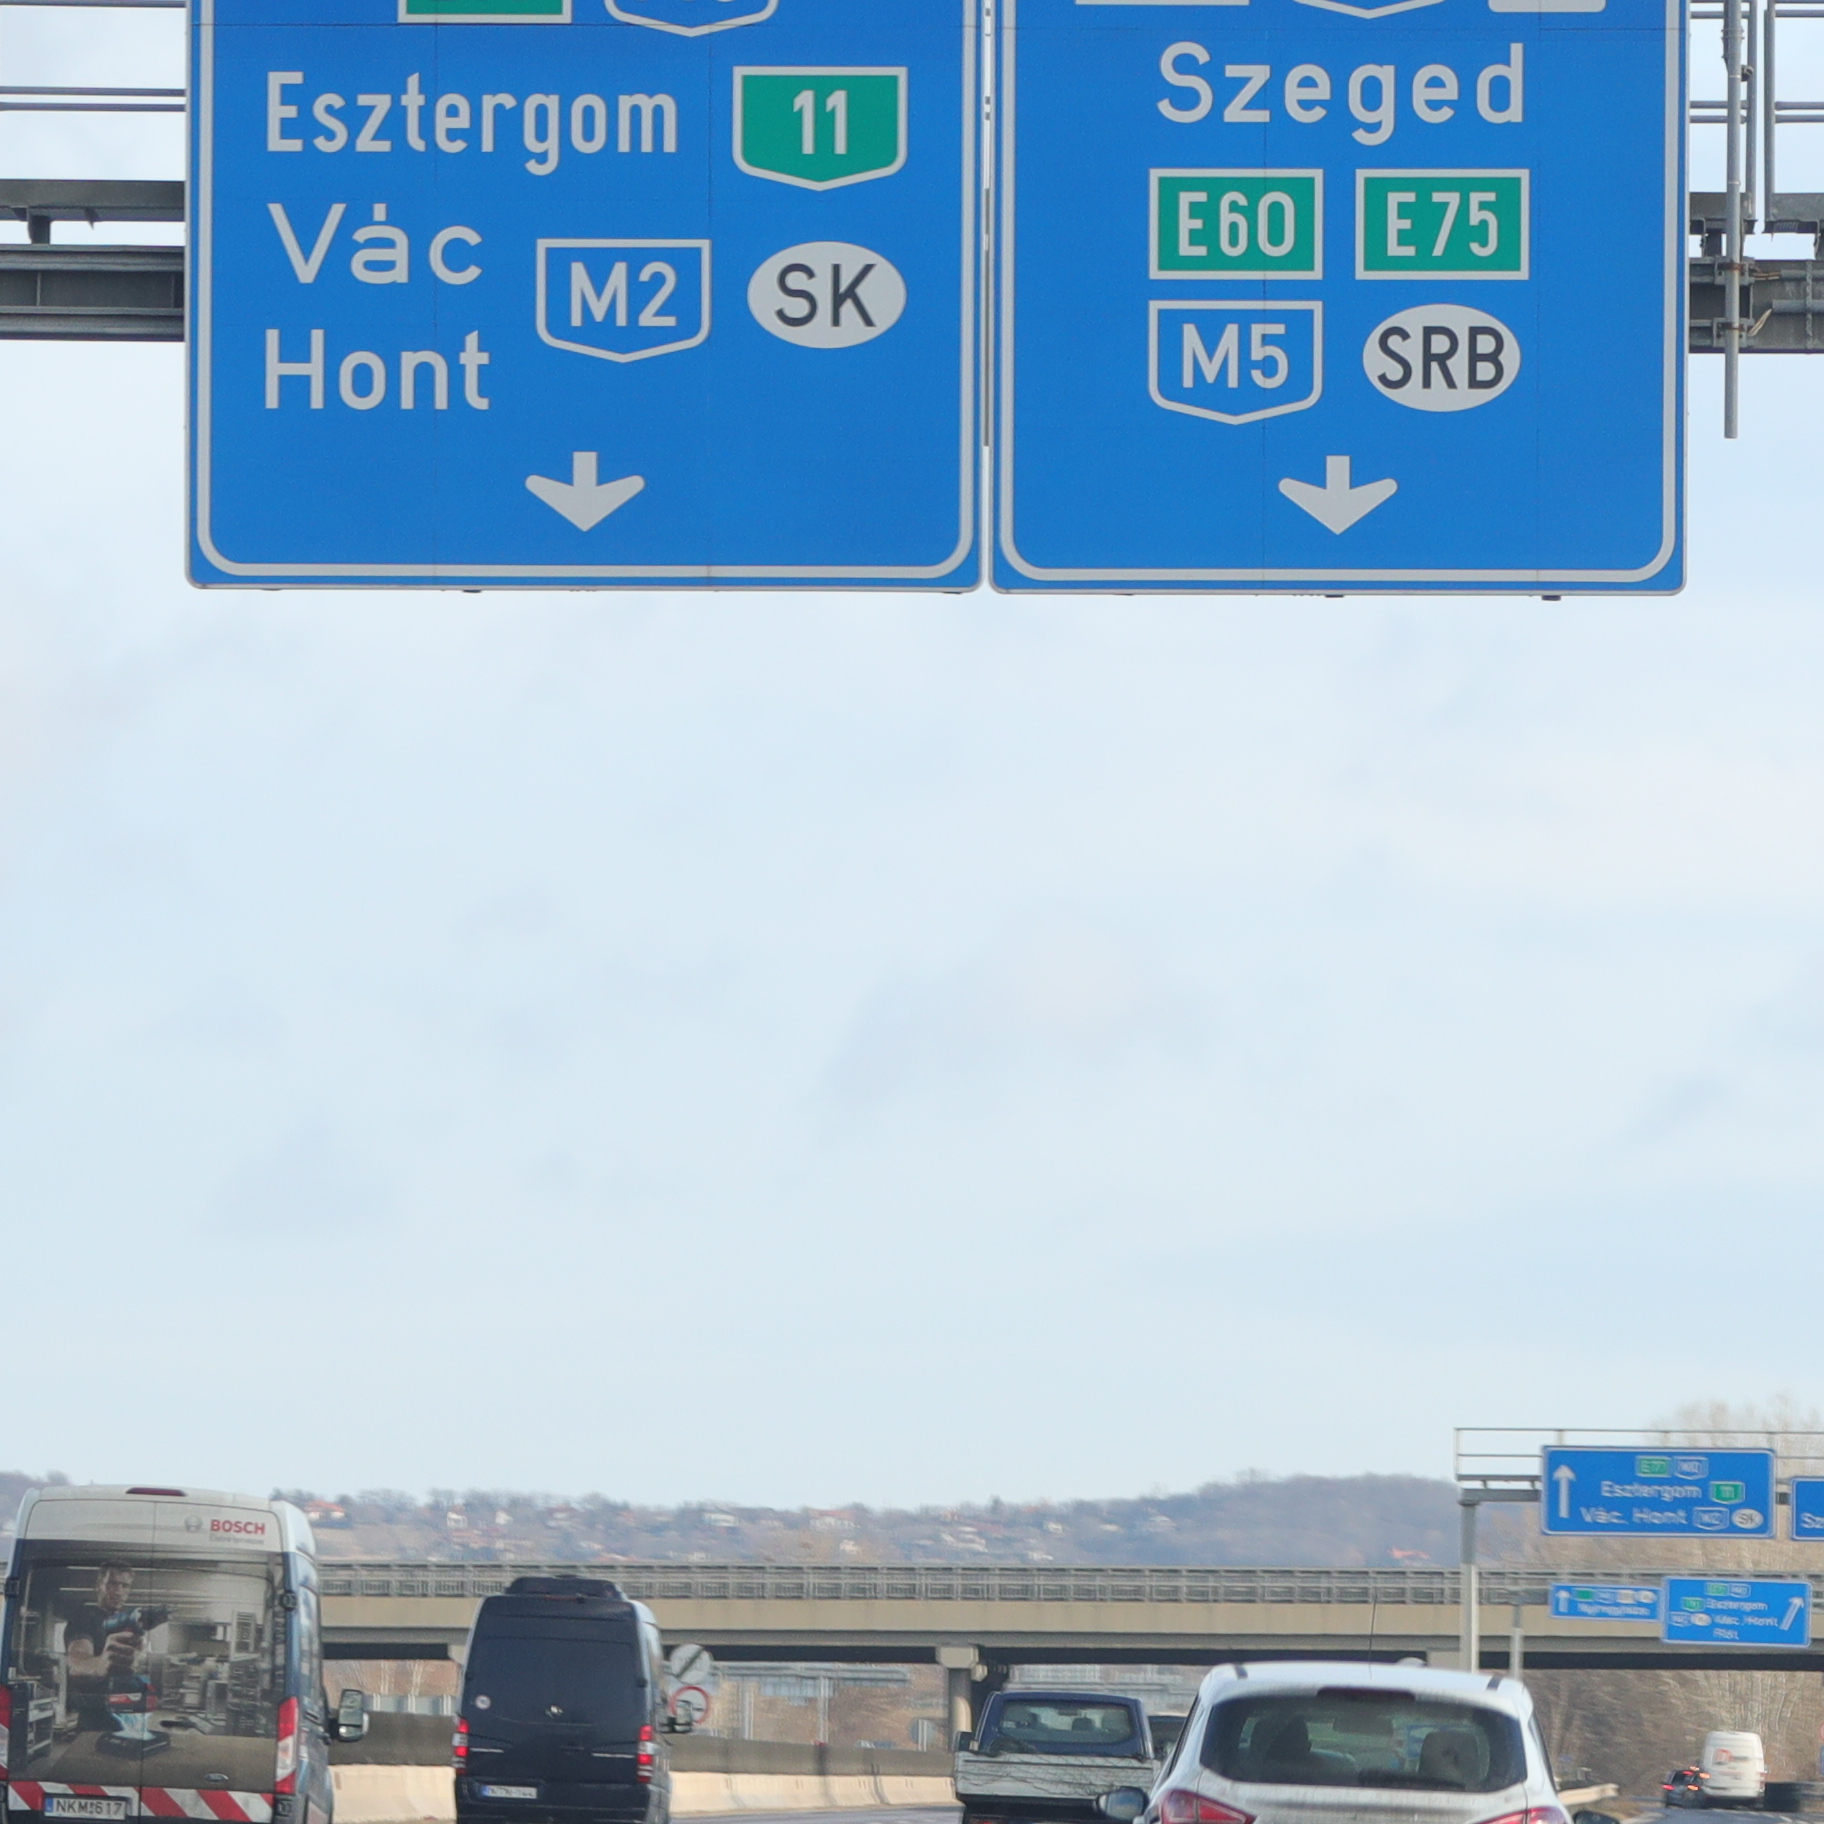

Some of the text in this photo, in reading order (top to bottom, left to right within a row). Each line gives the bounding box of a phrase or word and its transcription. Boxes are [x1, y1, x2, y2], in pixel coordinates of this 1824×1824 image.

[266, 70, 678, 176] Esztergom
[792, 89, 849, 155] 11
[1156, 41, 1525, 147] Szeged
[267, 202, 483, 285] Vác
[1178, 190, 1297, 258] E60
[1386, 191, 1499, 258] E75
[570, 261, 678, 328] M2
[773, 263, 878, 329] SK
[264, 328, 491, 411] Hont
[1181, 323, 1289, 389] M5
[1376, 325, 1506, 391] SRB
[1600, 1480, 1703, 1502] Esztergom
[210, 1518, 266, 1536] BOSCH
